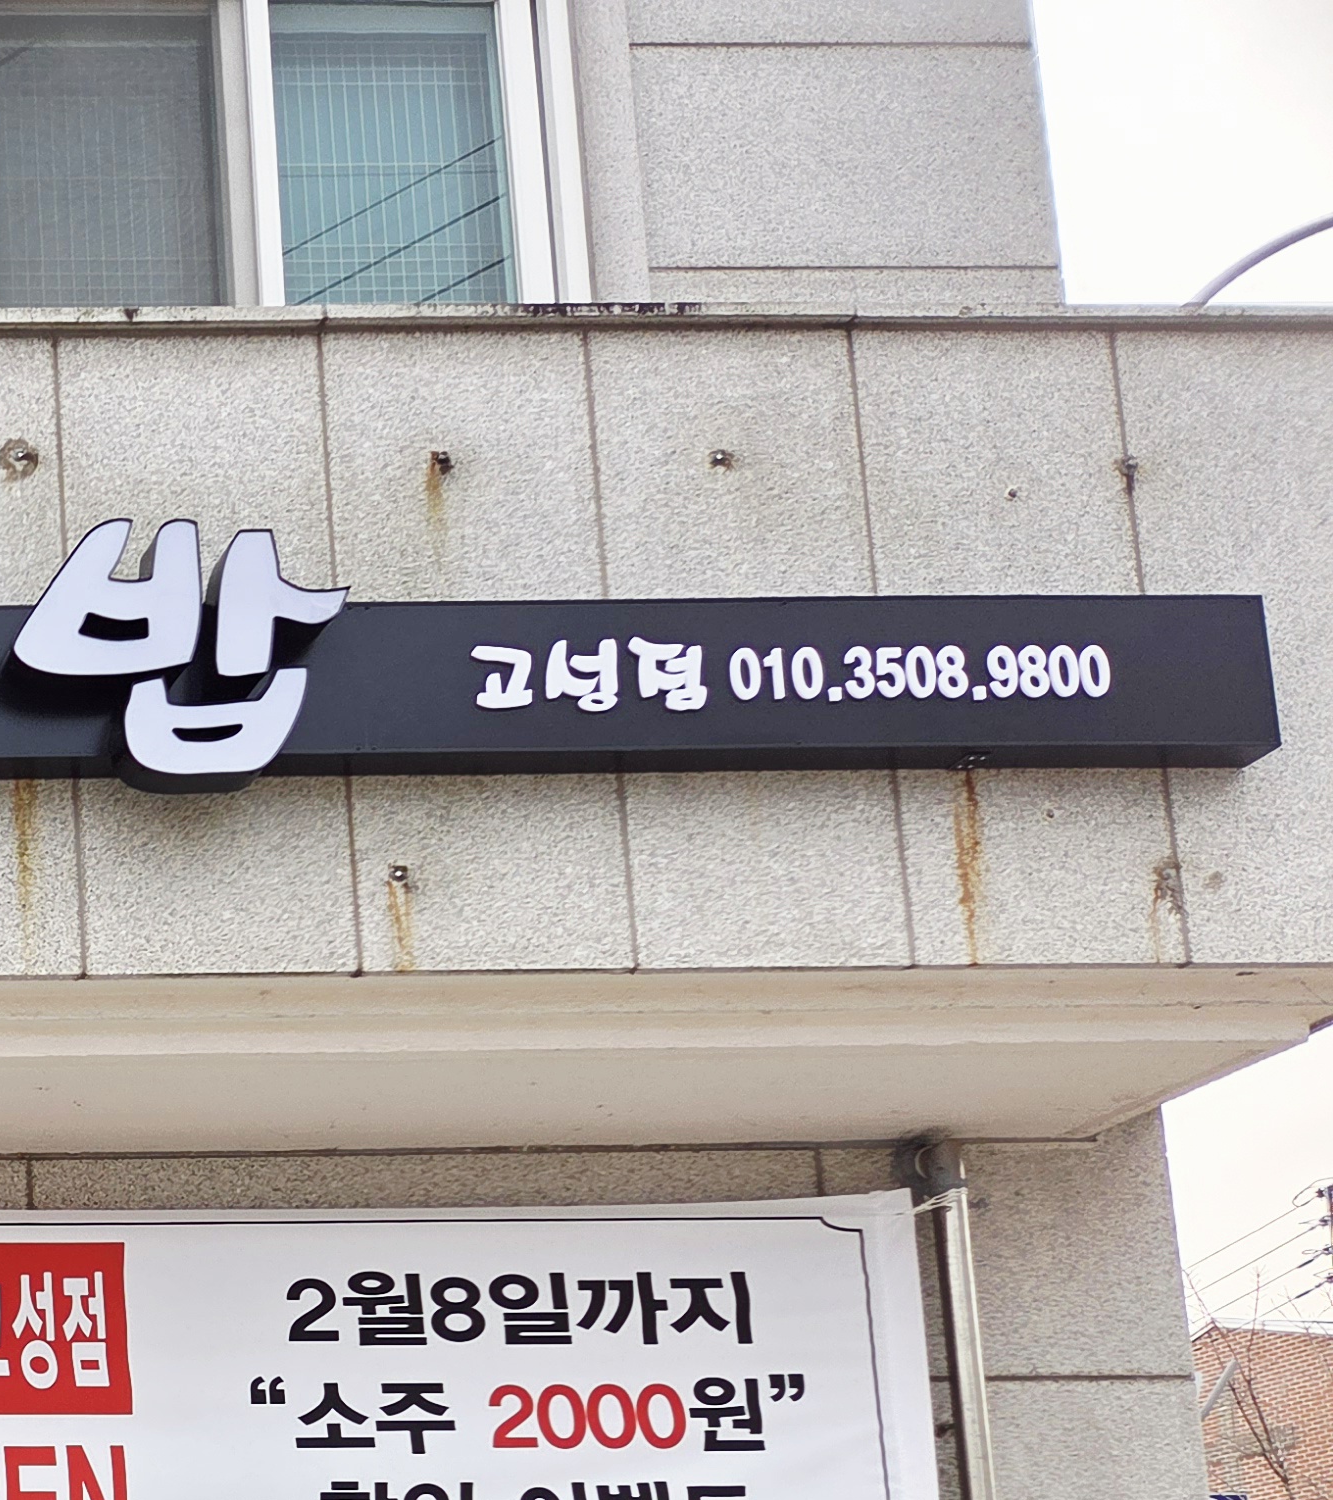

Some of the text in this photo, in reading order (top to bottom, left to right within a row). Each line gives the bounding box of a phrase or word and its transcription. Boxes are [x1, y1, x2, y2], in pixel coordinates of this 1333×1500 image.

[471, 637, 1111, 712] 고성점 010.3508.9800
[286, 1271, 753, 1346] 2월8일까지
